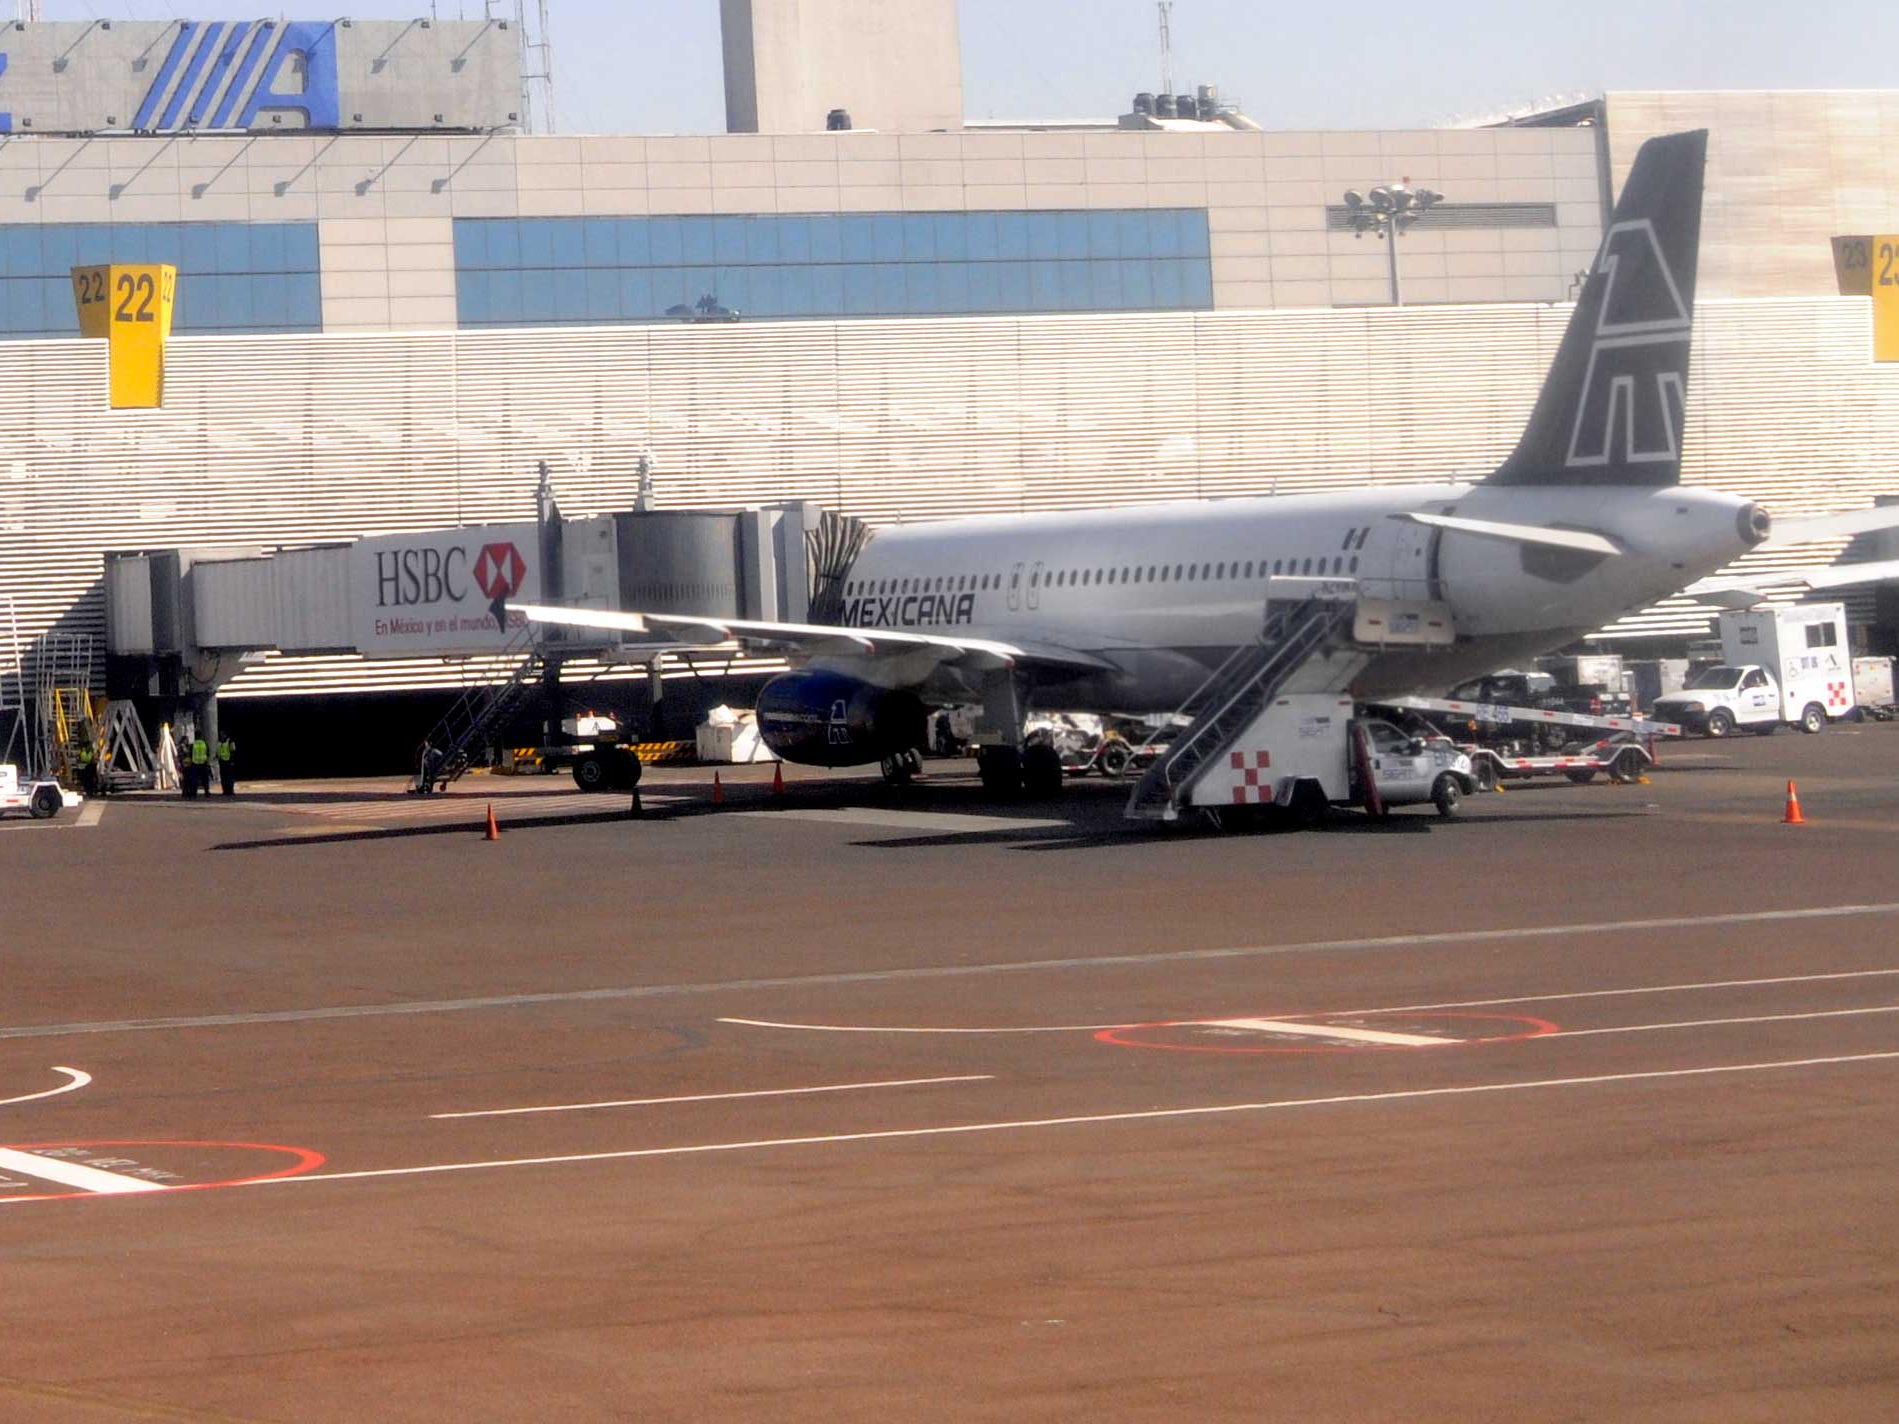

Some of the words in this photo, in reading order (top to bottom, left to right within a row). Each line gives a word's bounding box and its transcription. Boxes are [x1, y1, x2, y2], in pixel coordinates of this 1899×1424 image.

[79, 272, 105, 304] 22
[114, 273, 155, 322] 22
[374, 546, 467, 607] HSBC
[375, 619, 389, 636] En
[390, 617, 424, 635] México
[425, 620, 432, 637] y
[838, 593, 976, 628] MEXICANA
